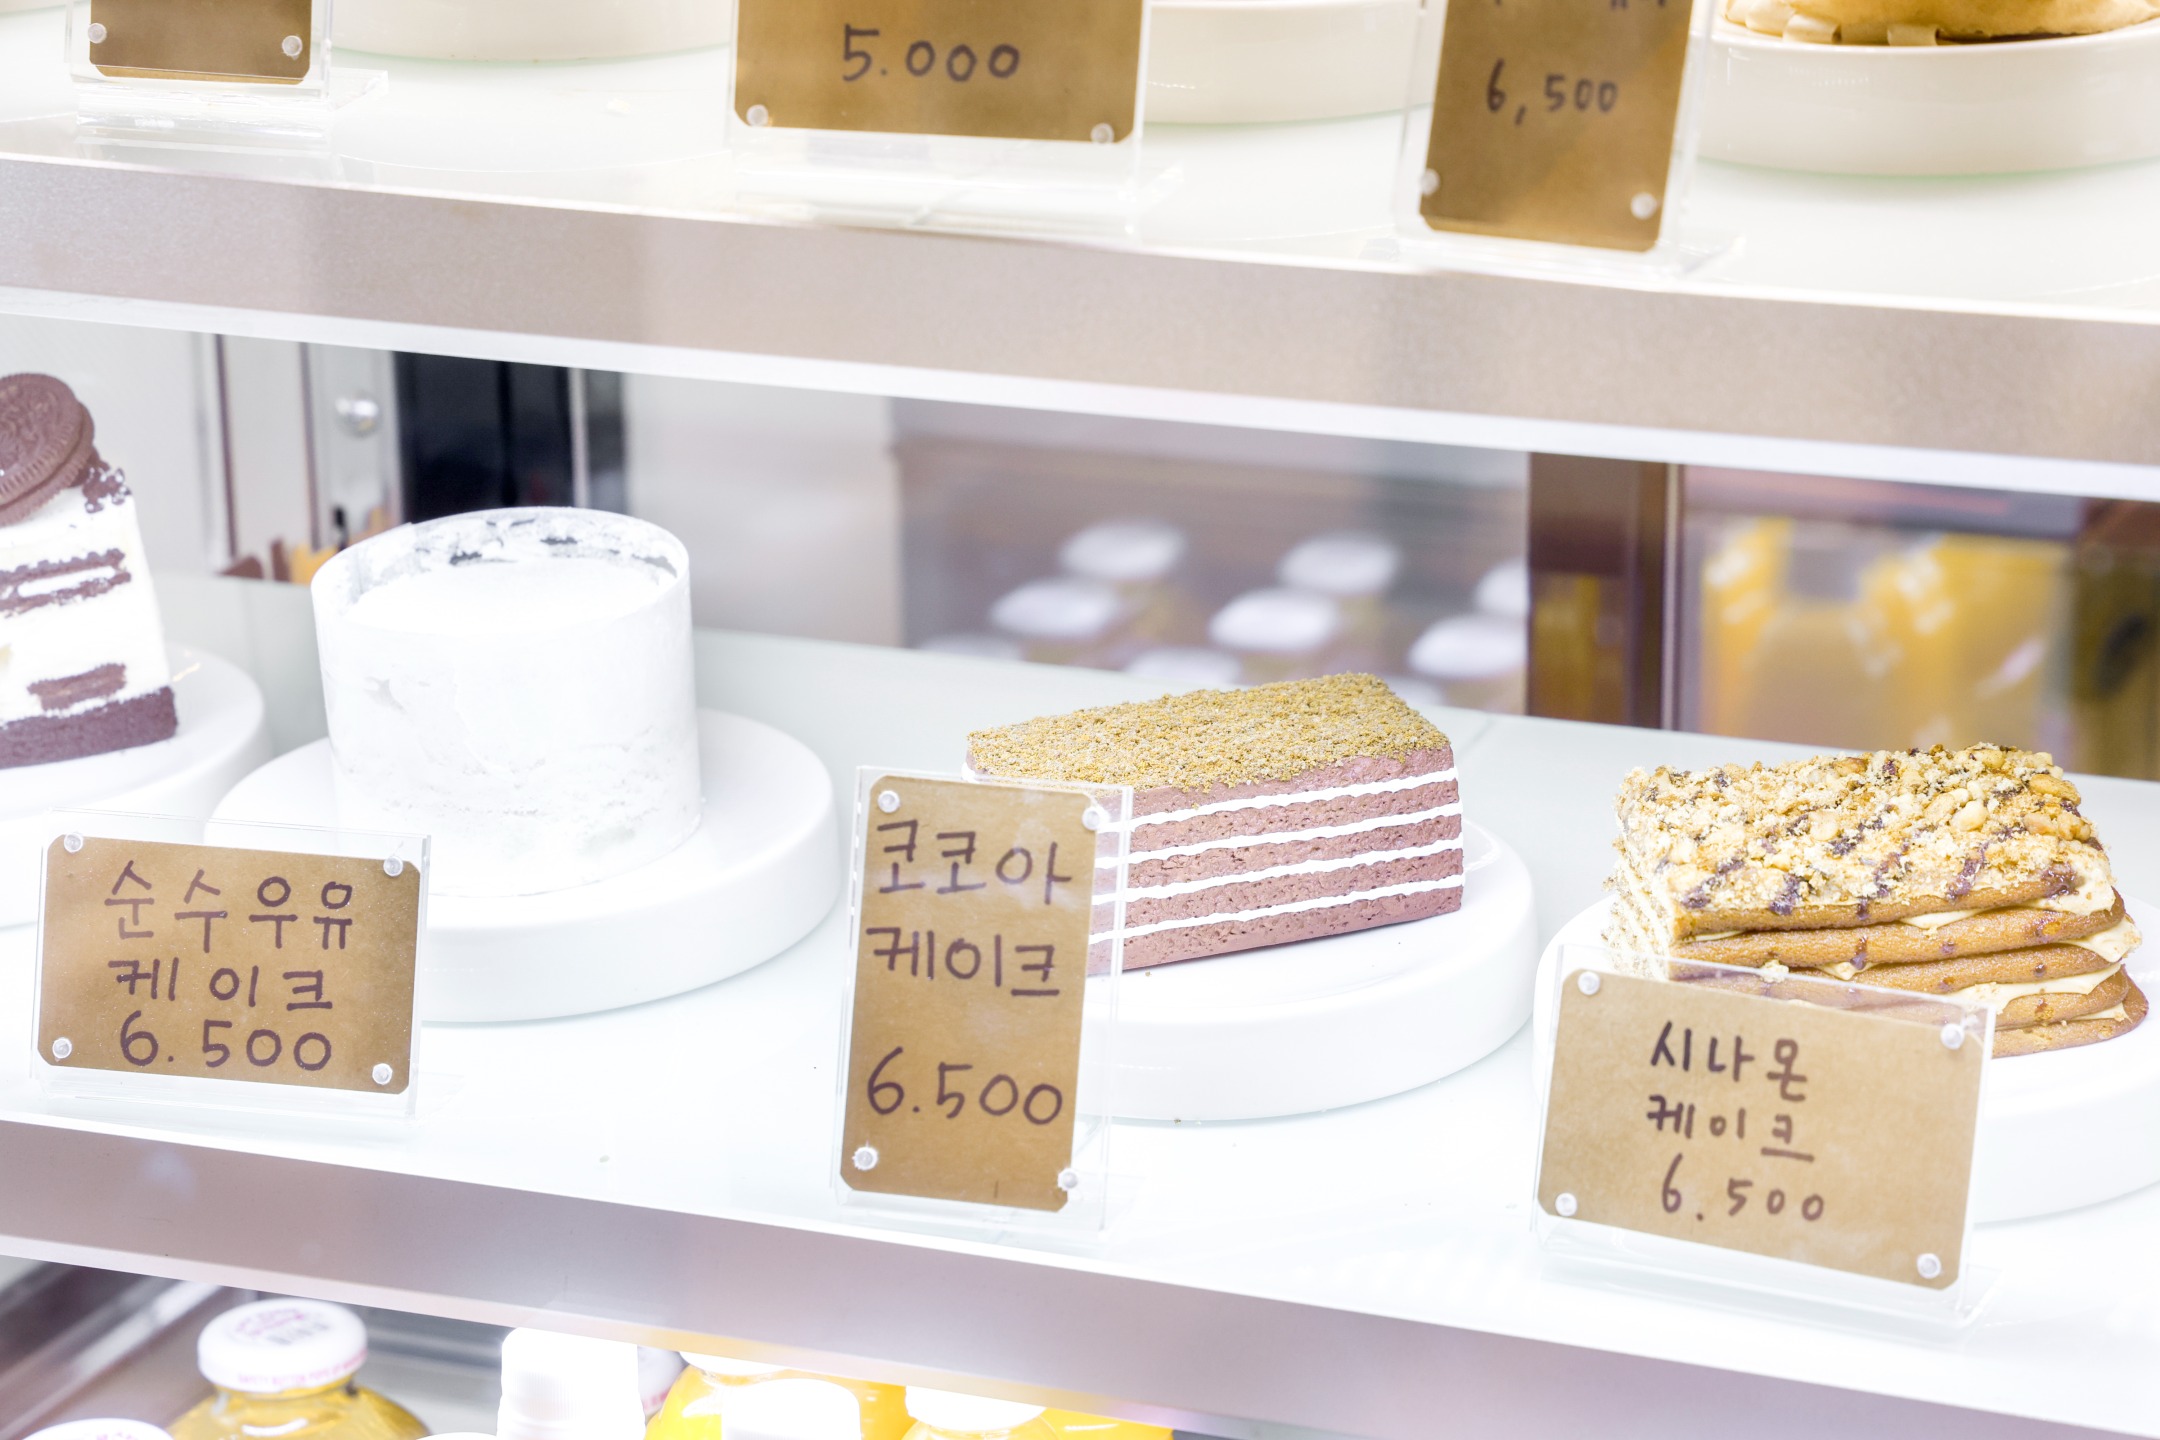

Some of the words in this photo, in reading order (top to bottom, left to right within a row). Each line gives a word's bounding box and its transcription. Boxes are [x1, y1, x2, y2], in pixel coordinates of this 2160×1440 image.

[843, 24, 1020, 82] 5.000
[876, 819, 1073, 906] 코코아
[104, 860, 353, 954] 순수우유
[108, 957, 333, 1011] 케이크
[866, 927, 1060, 997] 케이크
[119, 1010, 332, 1072] 6.500
[867, 1046, 1063, 1125] 6.500
[1646, 1094, 1815, 1163] 케이크
[1661, 1153, 1825, 1222] 6.500
